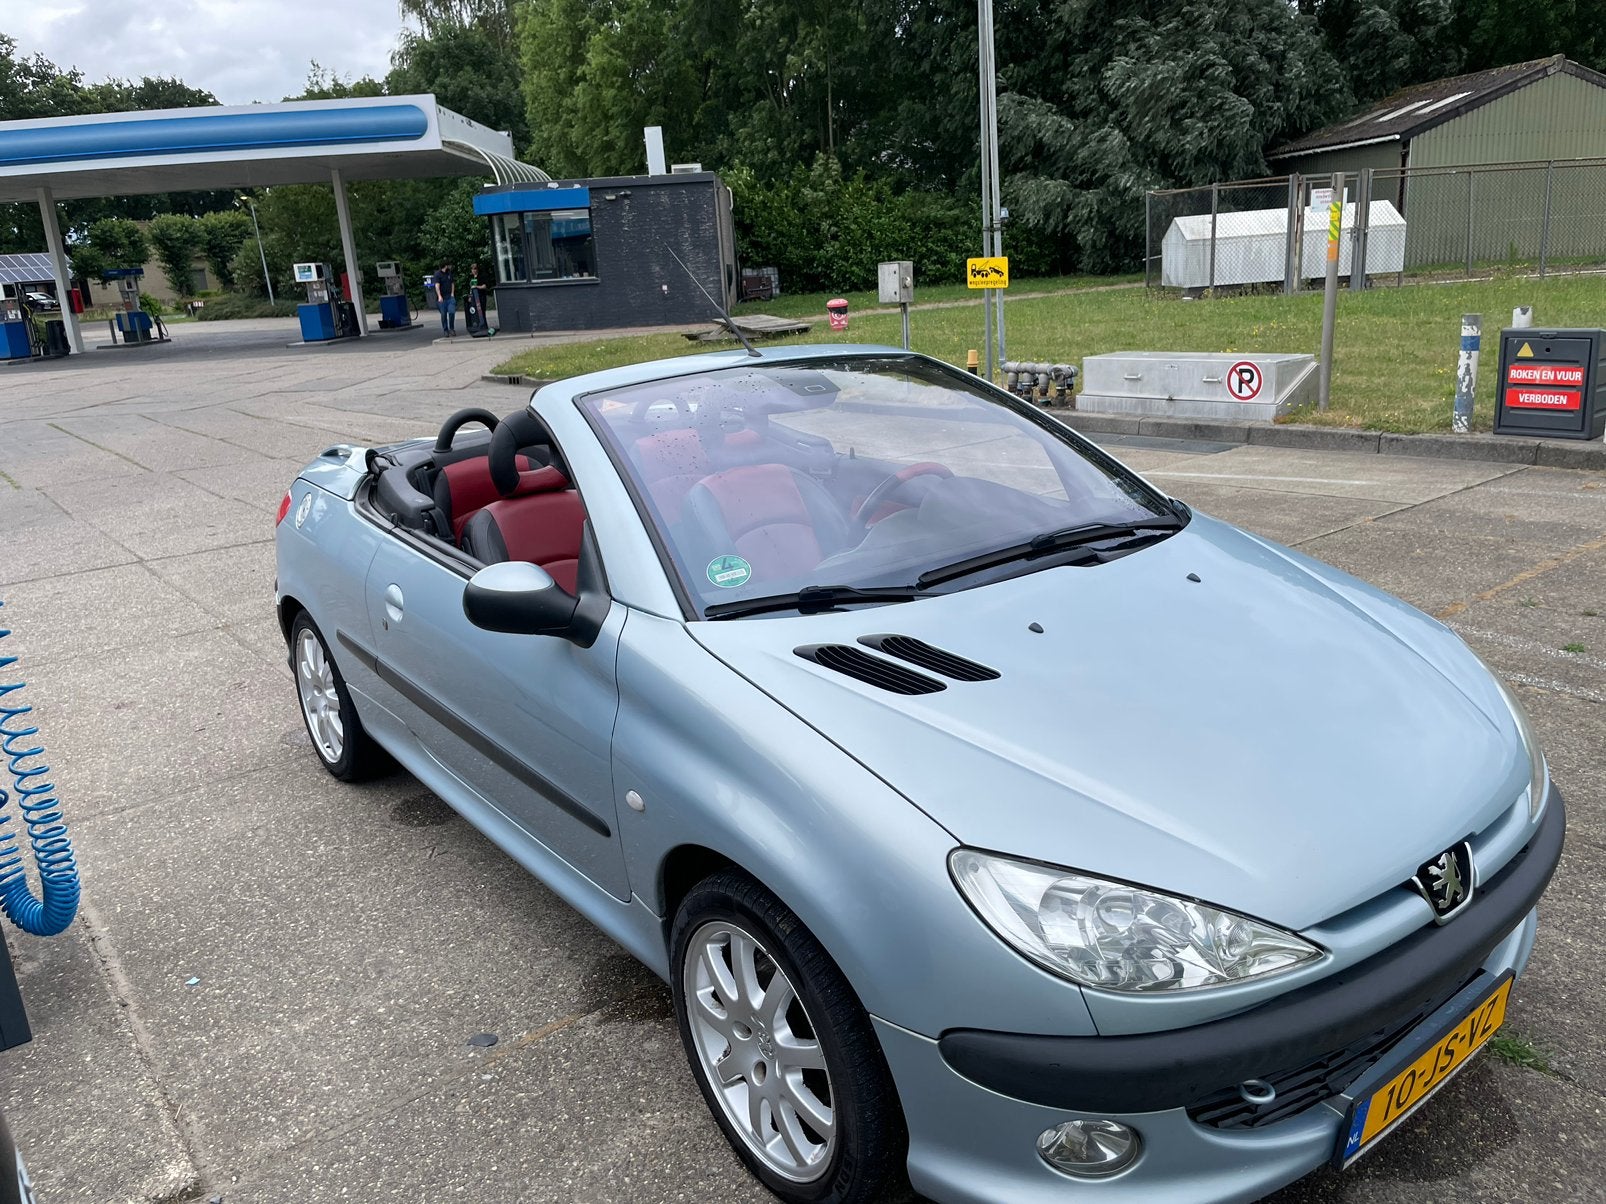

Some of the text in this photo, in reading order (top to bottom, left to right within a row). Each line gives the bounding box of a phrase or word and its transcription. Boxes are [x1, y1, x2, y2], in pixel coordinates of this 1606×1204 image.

[1238, 368, 1255, 394] P
[1510, 369, 1582, 381] ROKEN EN VUUR
[1518, 393, 1568, 405] VERBODEN
[1383, 994, 1500, 1122] 10-JS-VZ
[1346, 1131, 1360, 1148] NL
